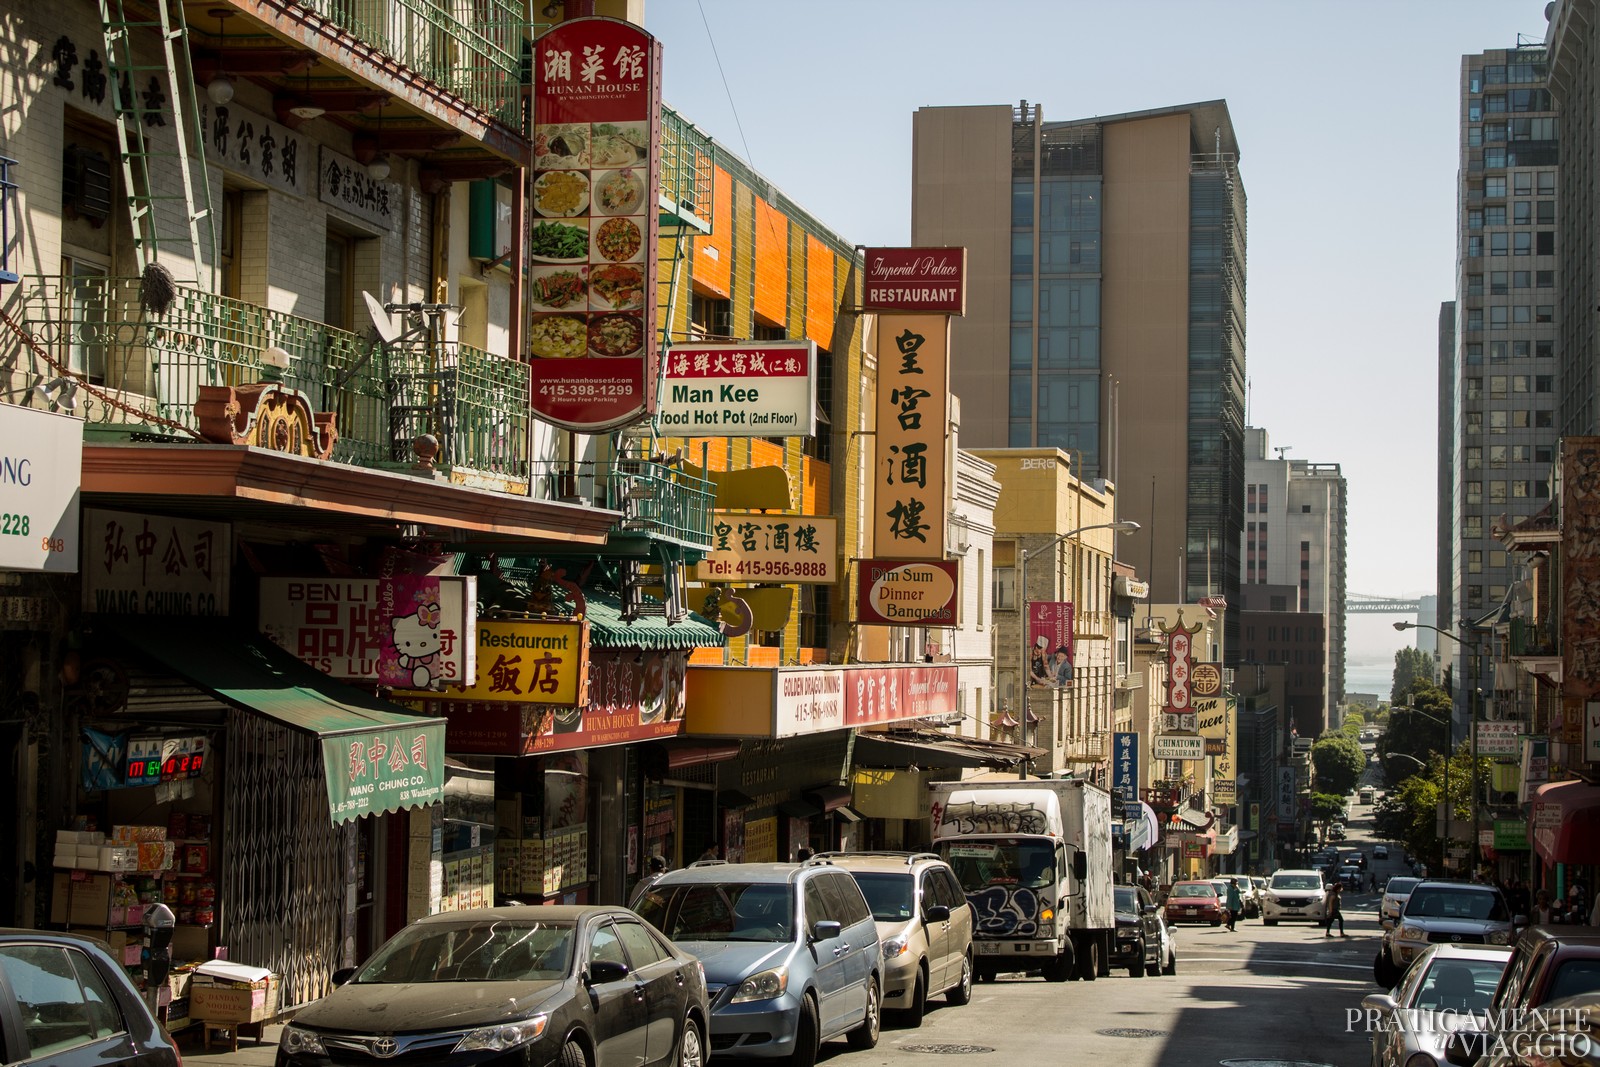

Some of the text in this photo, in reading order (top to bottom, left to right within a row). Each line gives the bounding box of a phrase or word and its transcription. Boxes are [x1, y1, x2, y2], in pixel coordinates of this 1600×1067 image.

[544, 44, 646, 84] 湘菜館
[547, 83, 640, 95] HUNAN HOUSE
[871, 256, 957, 280] Imperial Palace
[870, 288, 957, 302] RESTAURANT
[539, 385, 633, 396] 415-398-1299
[672, 384, 759, 403] Man Kee
[694, 410, 718, 424] Hot
[723, 409, 746, 424] Pot
[750, 412, 768, 426] (2nd
[771, 412, 798, 426] Floor)
[886, 328, 932, 544] 皇宮酒樓
[1020, 458, 1056, 470] BERG
[41, 537, 64, 552] 848
[714, 520, 820, 554] 皇宮酒樓
[104, 519, 213, 586] 弘中公司
[707, 560, 827, 577] Tel: 415-956-9888
[872, 567, 933, 582] Dim Sum
[288, 583, 340, 601] BEN
[381, 582, 395, 617] Hello
[879, 586, 925, 601] Dinner
[96, 589, 139, 615] WANG
[145, 591, 193, 617] CHUNG
[886, 603, 951, 620] Banquets
[1062, 605, 1071, 648] community
[479, 629, 568, 649] Restaurant
[1174, 639, 1187, 703] 新杏香
[784, 676, 804, 697] GOLDEN
[804, 675, 824, 695] DRAGON
[795, 699, 838, 722] 415-956-9888
[1192, 700, 1218, 713] am
[586, 714, 634, 731] HUNAN HOUSE
[1198, 715, 1223, 729] uen
[1158, 739, 1201, 748] CHINATOWN
[349, 734, 427, 782] 弘中公司
[1158, 749, 1201, 757] RESTAURANT
[349, 775, 425, 796] WANG CHUNG CO.
